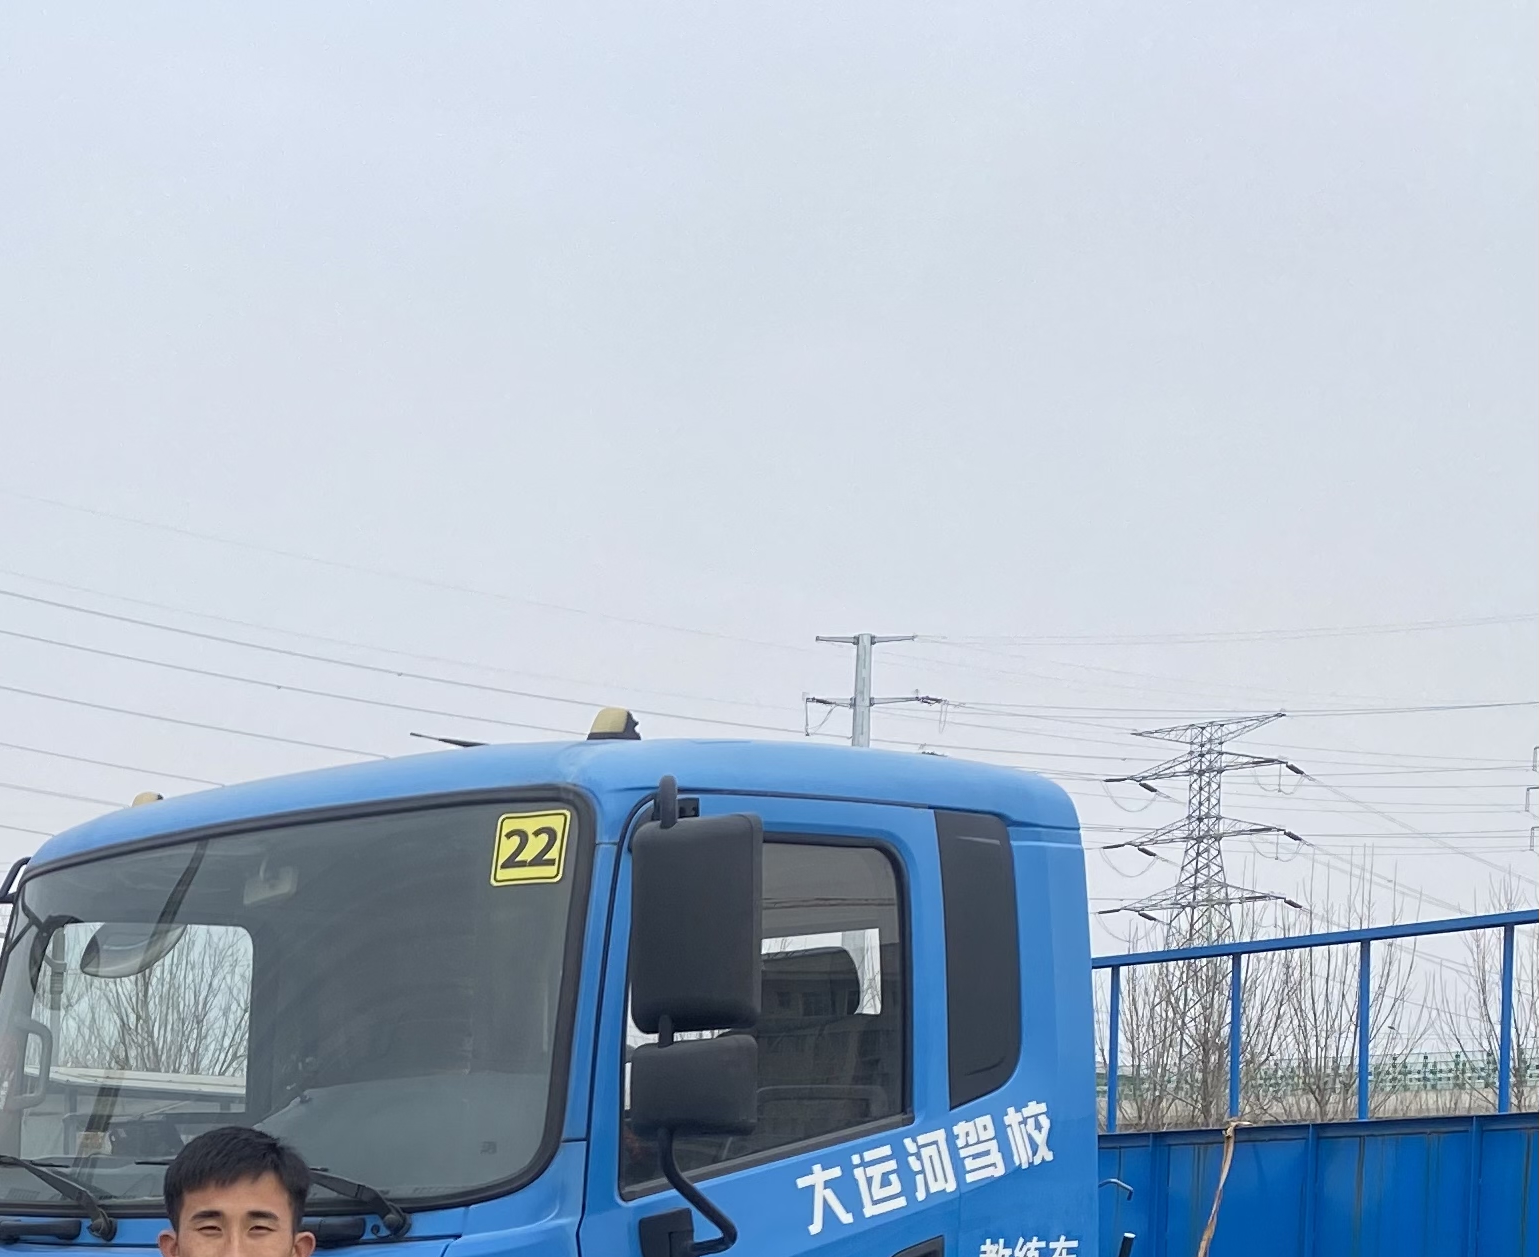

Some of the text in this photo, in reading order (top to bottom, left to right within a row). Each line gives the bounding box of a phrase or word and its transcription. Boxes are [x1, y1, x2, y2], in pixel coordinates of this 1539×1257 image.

[500, 826, 558, 870] 22
[796, 1100, 1054, 1236] 大运河驾校
